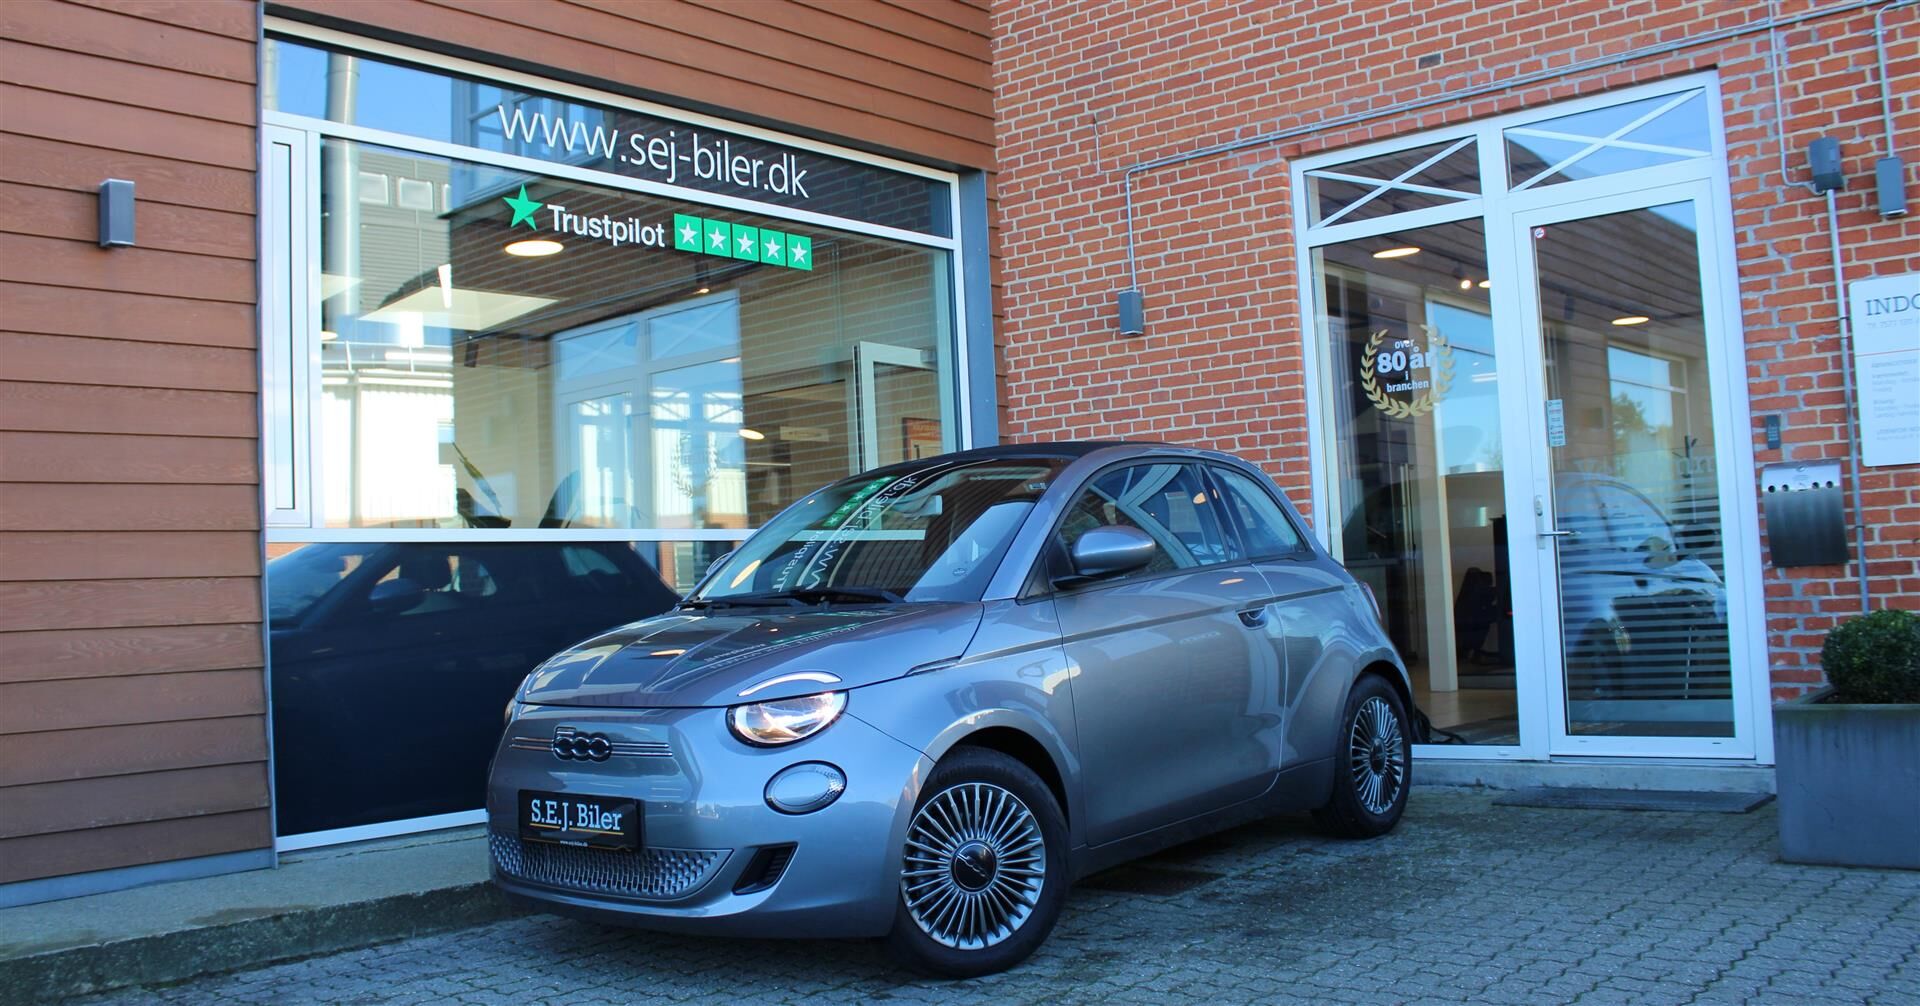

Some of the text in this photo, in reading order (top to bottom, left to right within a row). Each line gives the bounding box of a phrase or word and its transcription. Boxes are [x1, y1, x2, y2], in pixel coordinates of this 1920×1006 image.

[498, 105, 809, 198] www.sej-biler.dk
[547, 204, 666, 247] Trustpilot
[1394, 339, 1415, 350] over
[1378, 346, 1433, 373] 80 år
[1386, 380, 1429, 392] branchen
[1405, 371, 1409, 380] i
[531, 799, 622, 832] S.E.J. Biler
